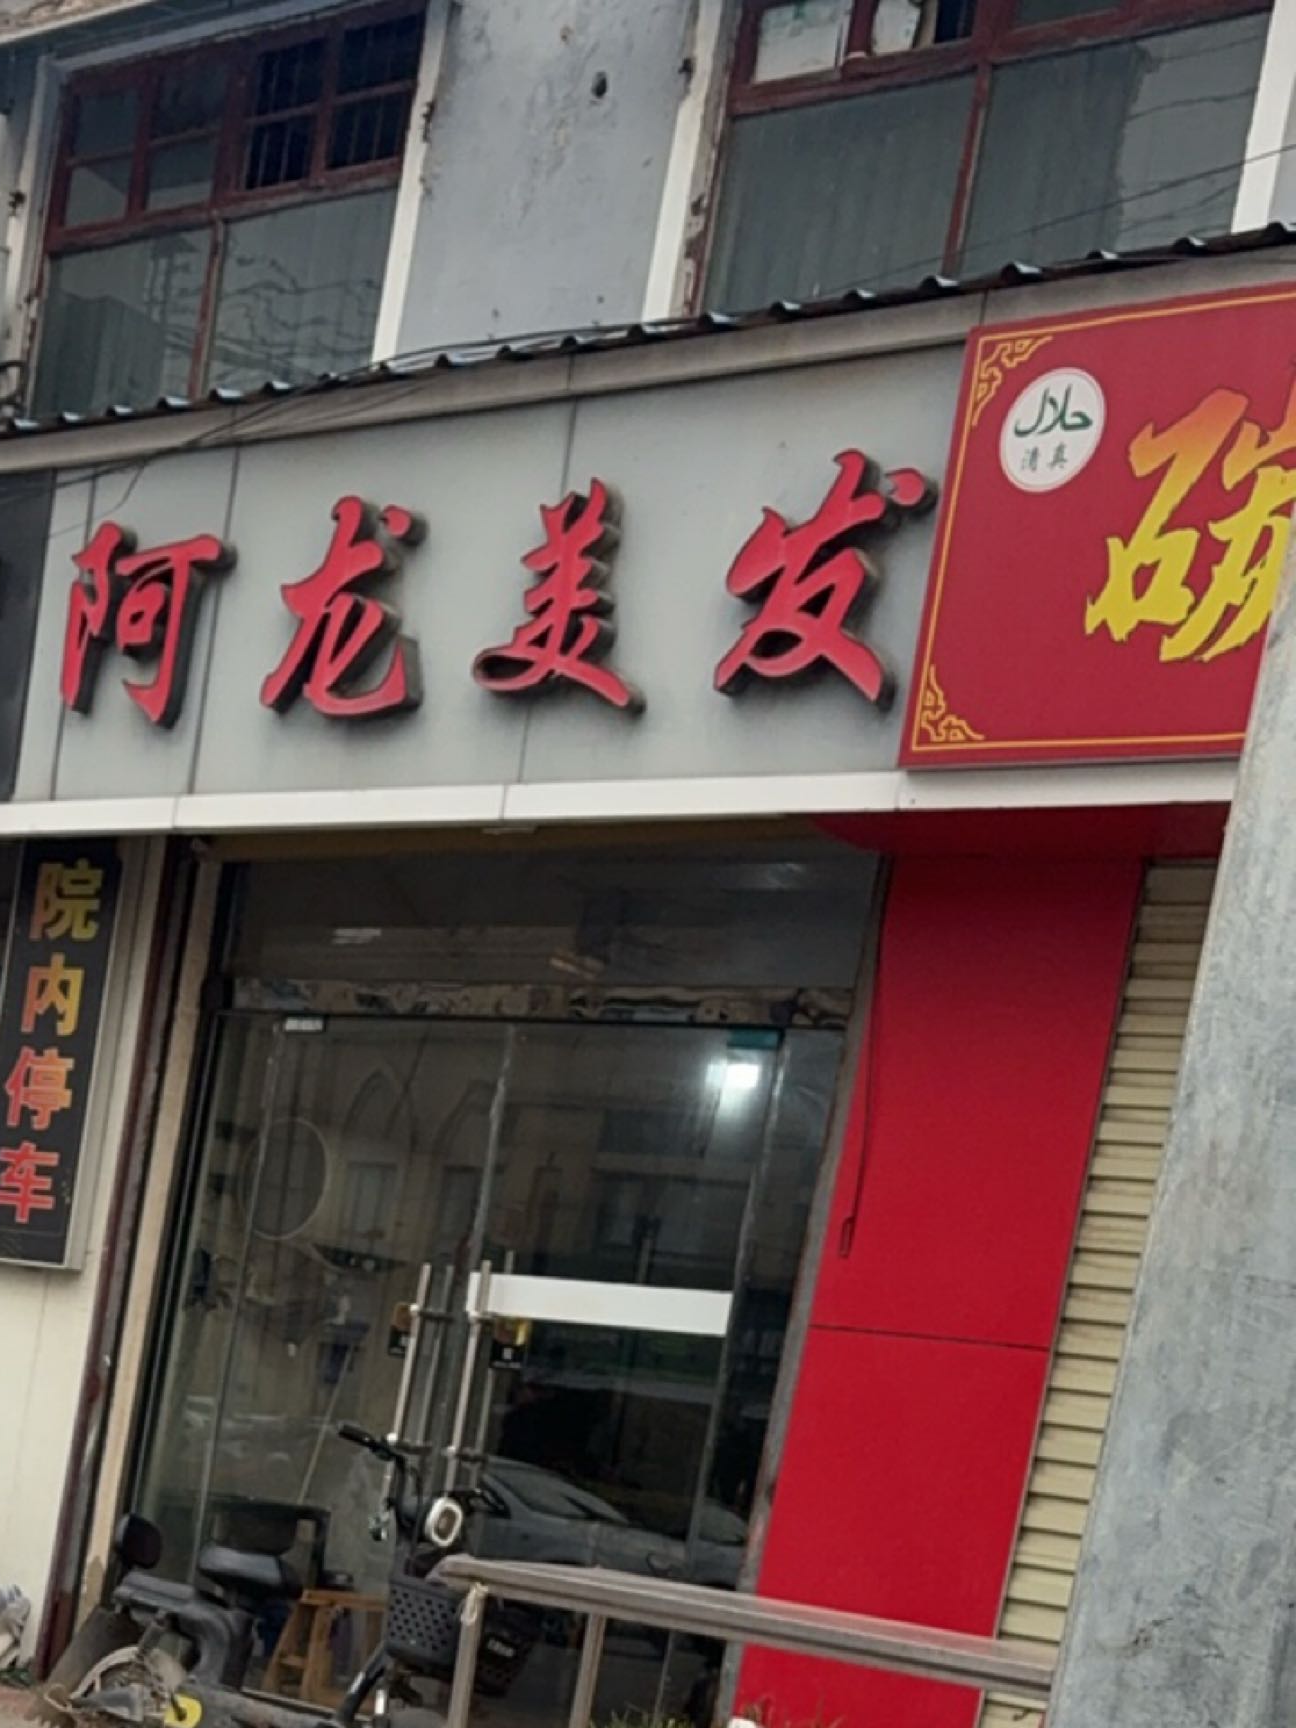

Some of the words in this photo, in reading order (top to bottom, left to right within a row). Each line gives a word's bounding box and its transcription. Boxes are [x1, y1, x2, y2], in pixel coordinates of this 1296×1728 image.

[1014, 383, 1094, 438] حلال
[60, 448, 932, 727] 阿龙美发
